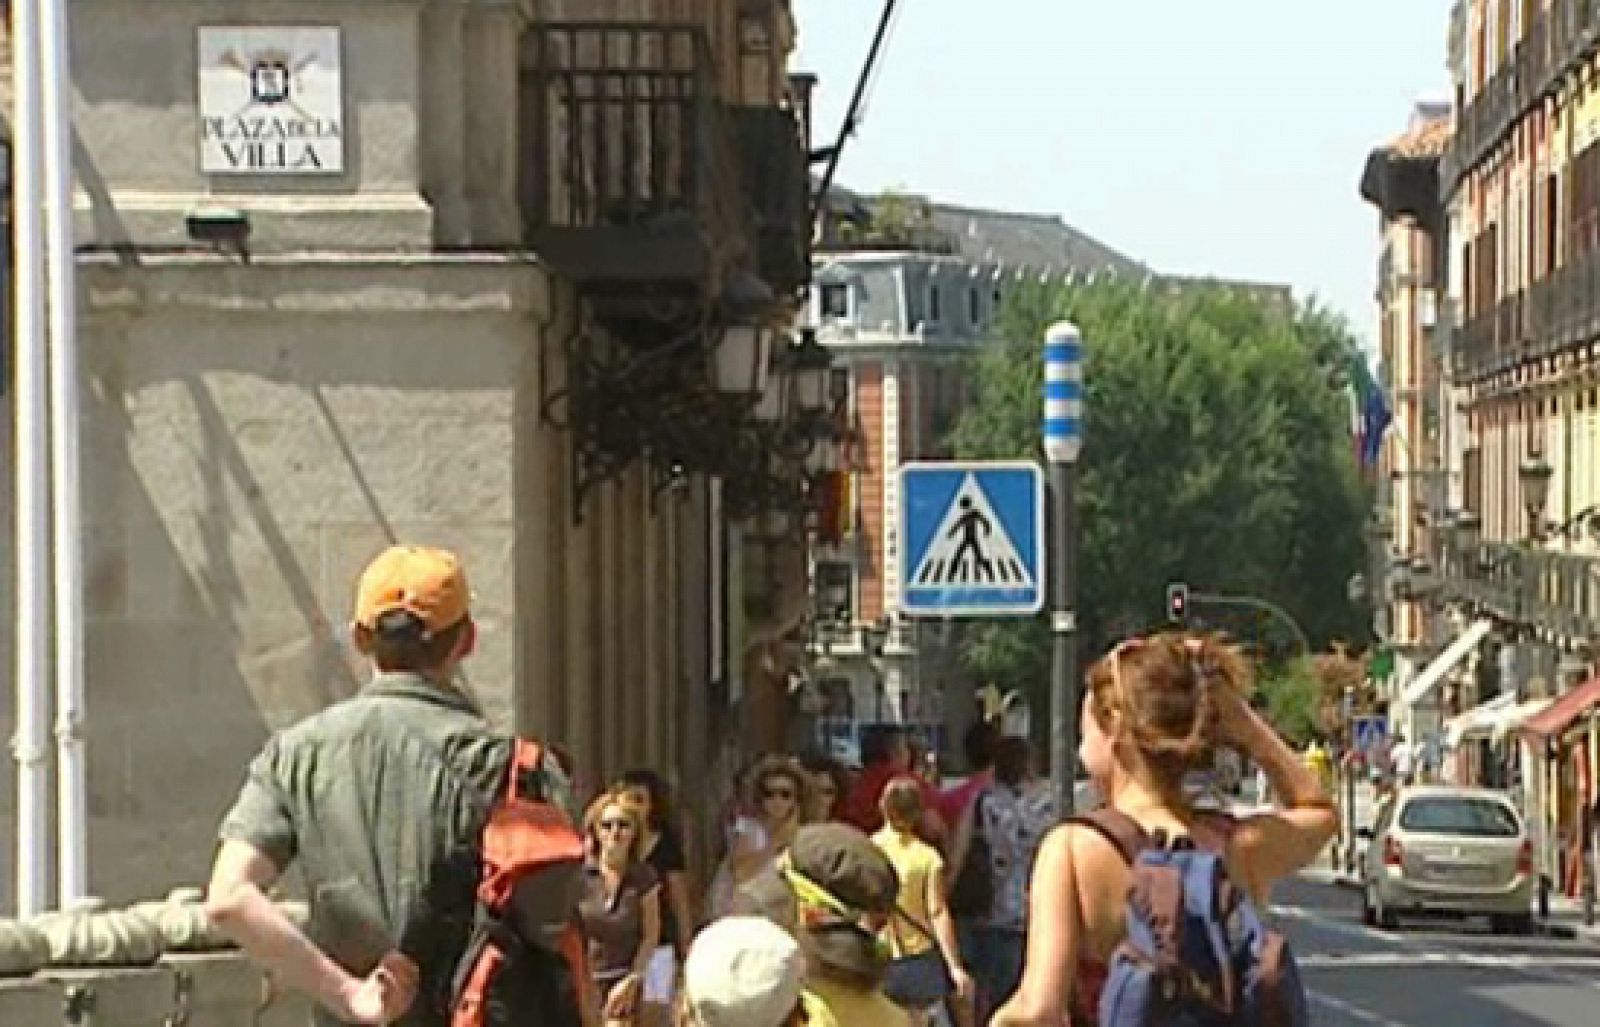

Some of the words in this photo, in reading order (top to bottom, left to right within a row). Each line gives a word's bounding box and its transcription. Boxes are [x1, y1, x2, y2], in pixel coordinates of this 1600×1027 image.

[202, 116, 286, 138] PLAZA
[314, 118, 340, 137] LA
[220, 143, 322, 167] VILLA
